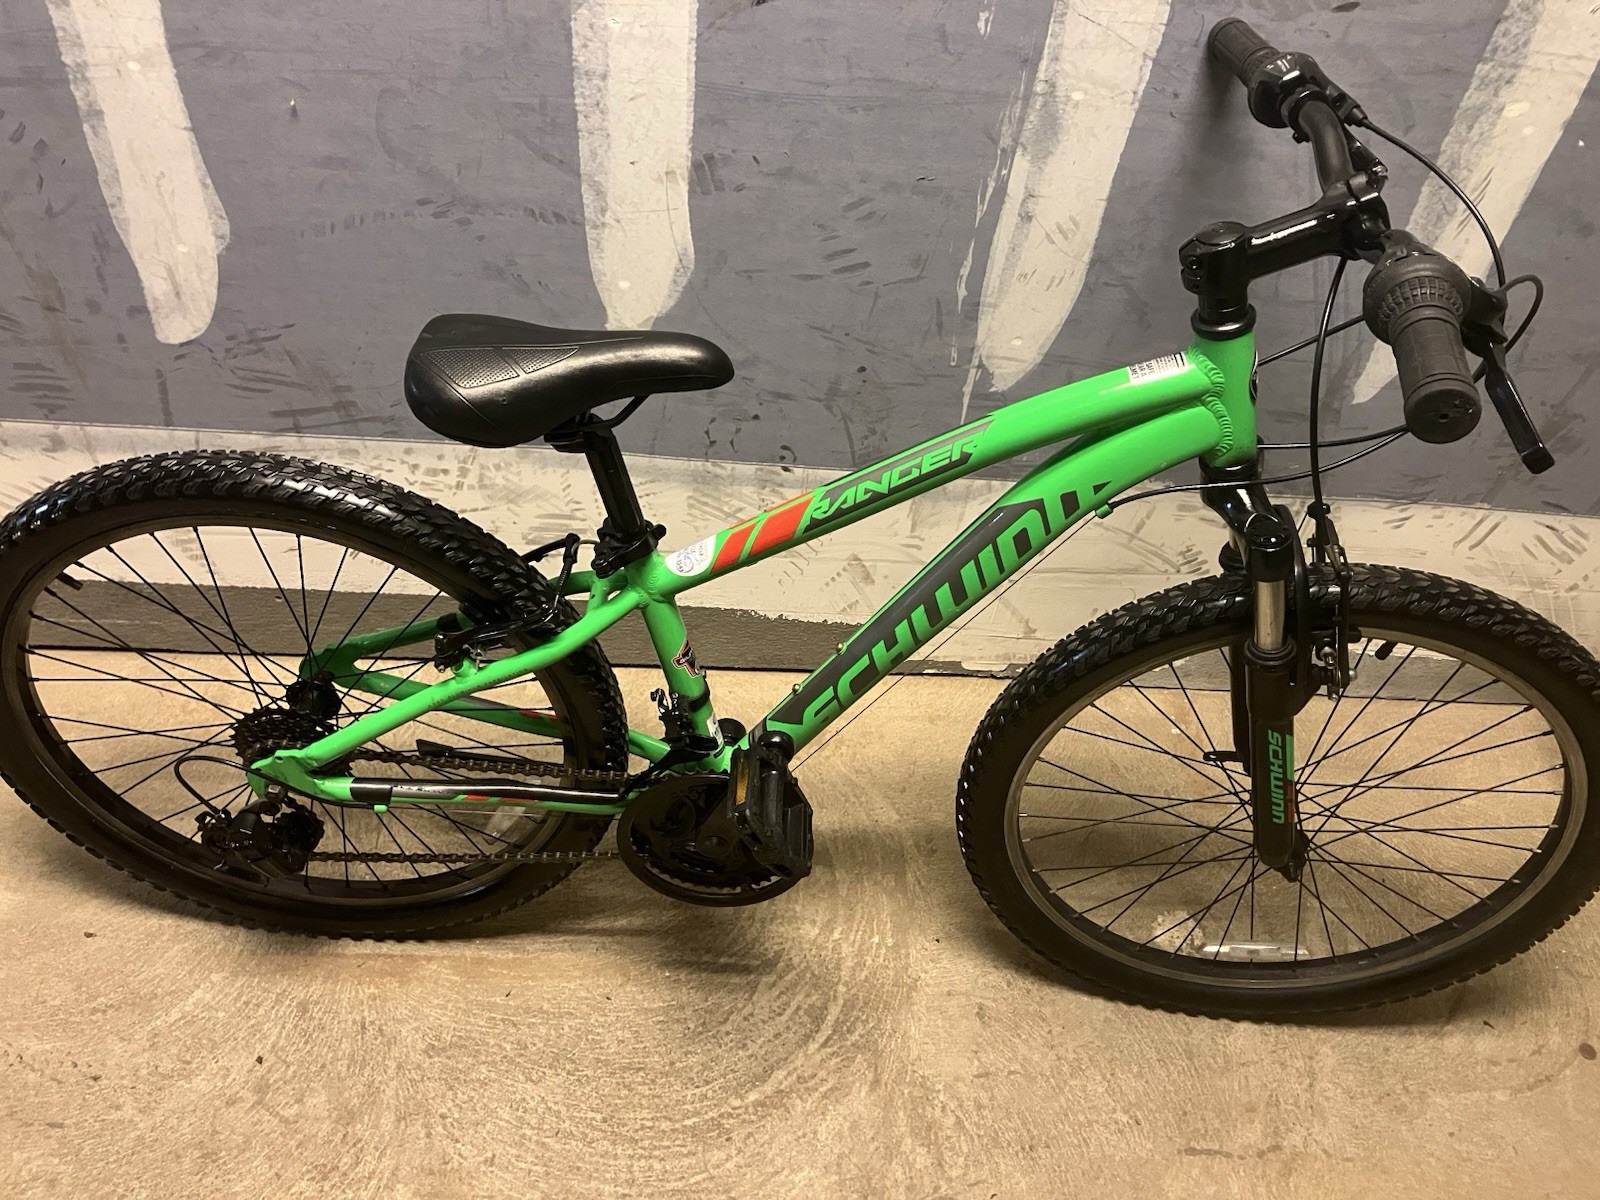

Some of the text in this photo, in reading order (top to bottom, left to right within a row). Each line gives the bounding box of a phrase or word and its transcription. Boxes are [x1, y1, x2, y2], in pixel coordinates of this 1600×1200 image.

[804, 432, 981, 526] RANGER
[802, 482, 1101, 727] SCHWINN
[1268, 729, 1285, 824] SCHWINN
